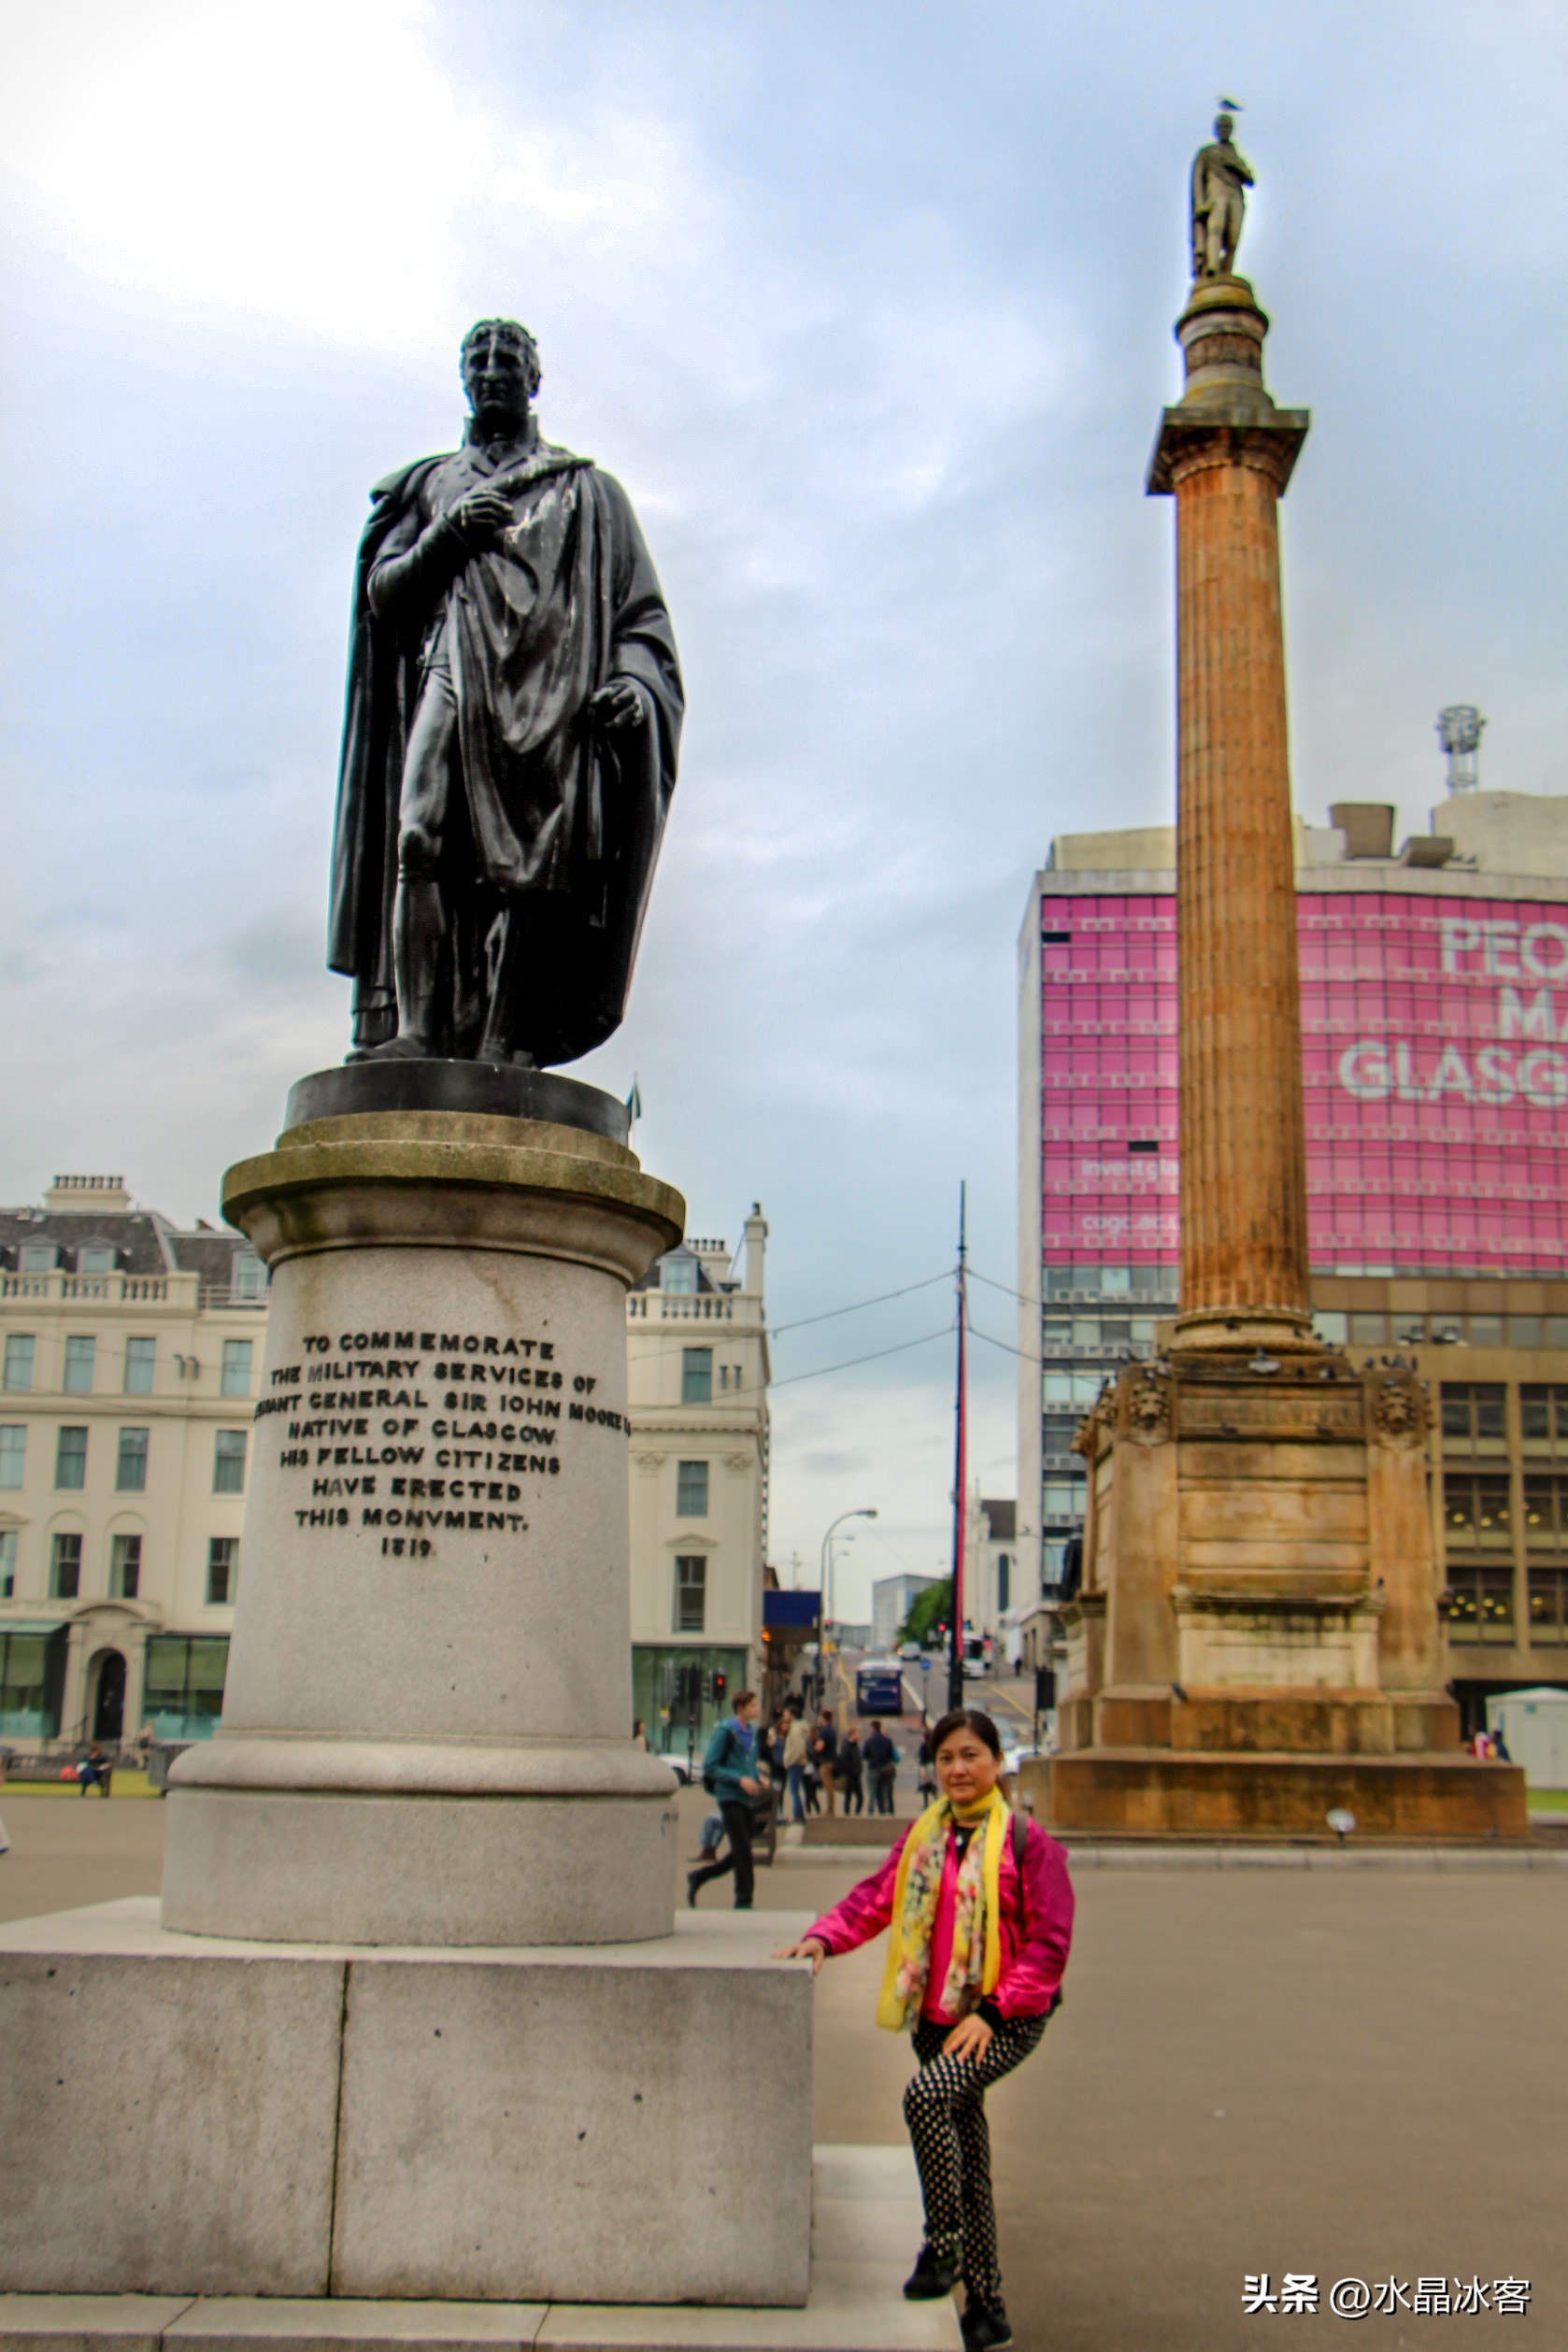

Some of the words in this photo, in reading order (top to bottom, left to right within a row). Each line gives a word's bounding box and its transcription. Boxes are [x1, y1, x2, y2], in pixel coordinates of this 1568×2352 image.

[303, 1335, 330, 1353] TO
[339, 1331, 554, 1361] COMMEMORATE
[270, 1365, 301, 1386] THE
[307, 1360, 420, 1382] MILITARY
[433, 1361, 563, 1390] SERVICES
[573, 1376, 596, 1394] OF
[444, 1391, 488, 1411] SIR
[568, 1403, 622, 1431] MOORE
[289, 1418, 368, 1439] NATIVE
[382, 1418, 419, 1436] OF
[280, 1449, 308, 1467] HIS
[317, 1447, 425, 1465] FELLOW
[435, 1448, 561, 1474] CITIZENS
[313, 1475, 376, 1496] HAVE
[392, 1476, 521, 1500] ERECTED
[295, 1508, 349, 1526] THIS
[381, 1537, 432, 1556] 1819
